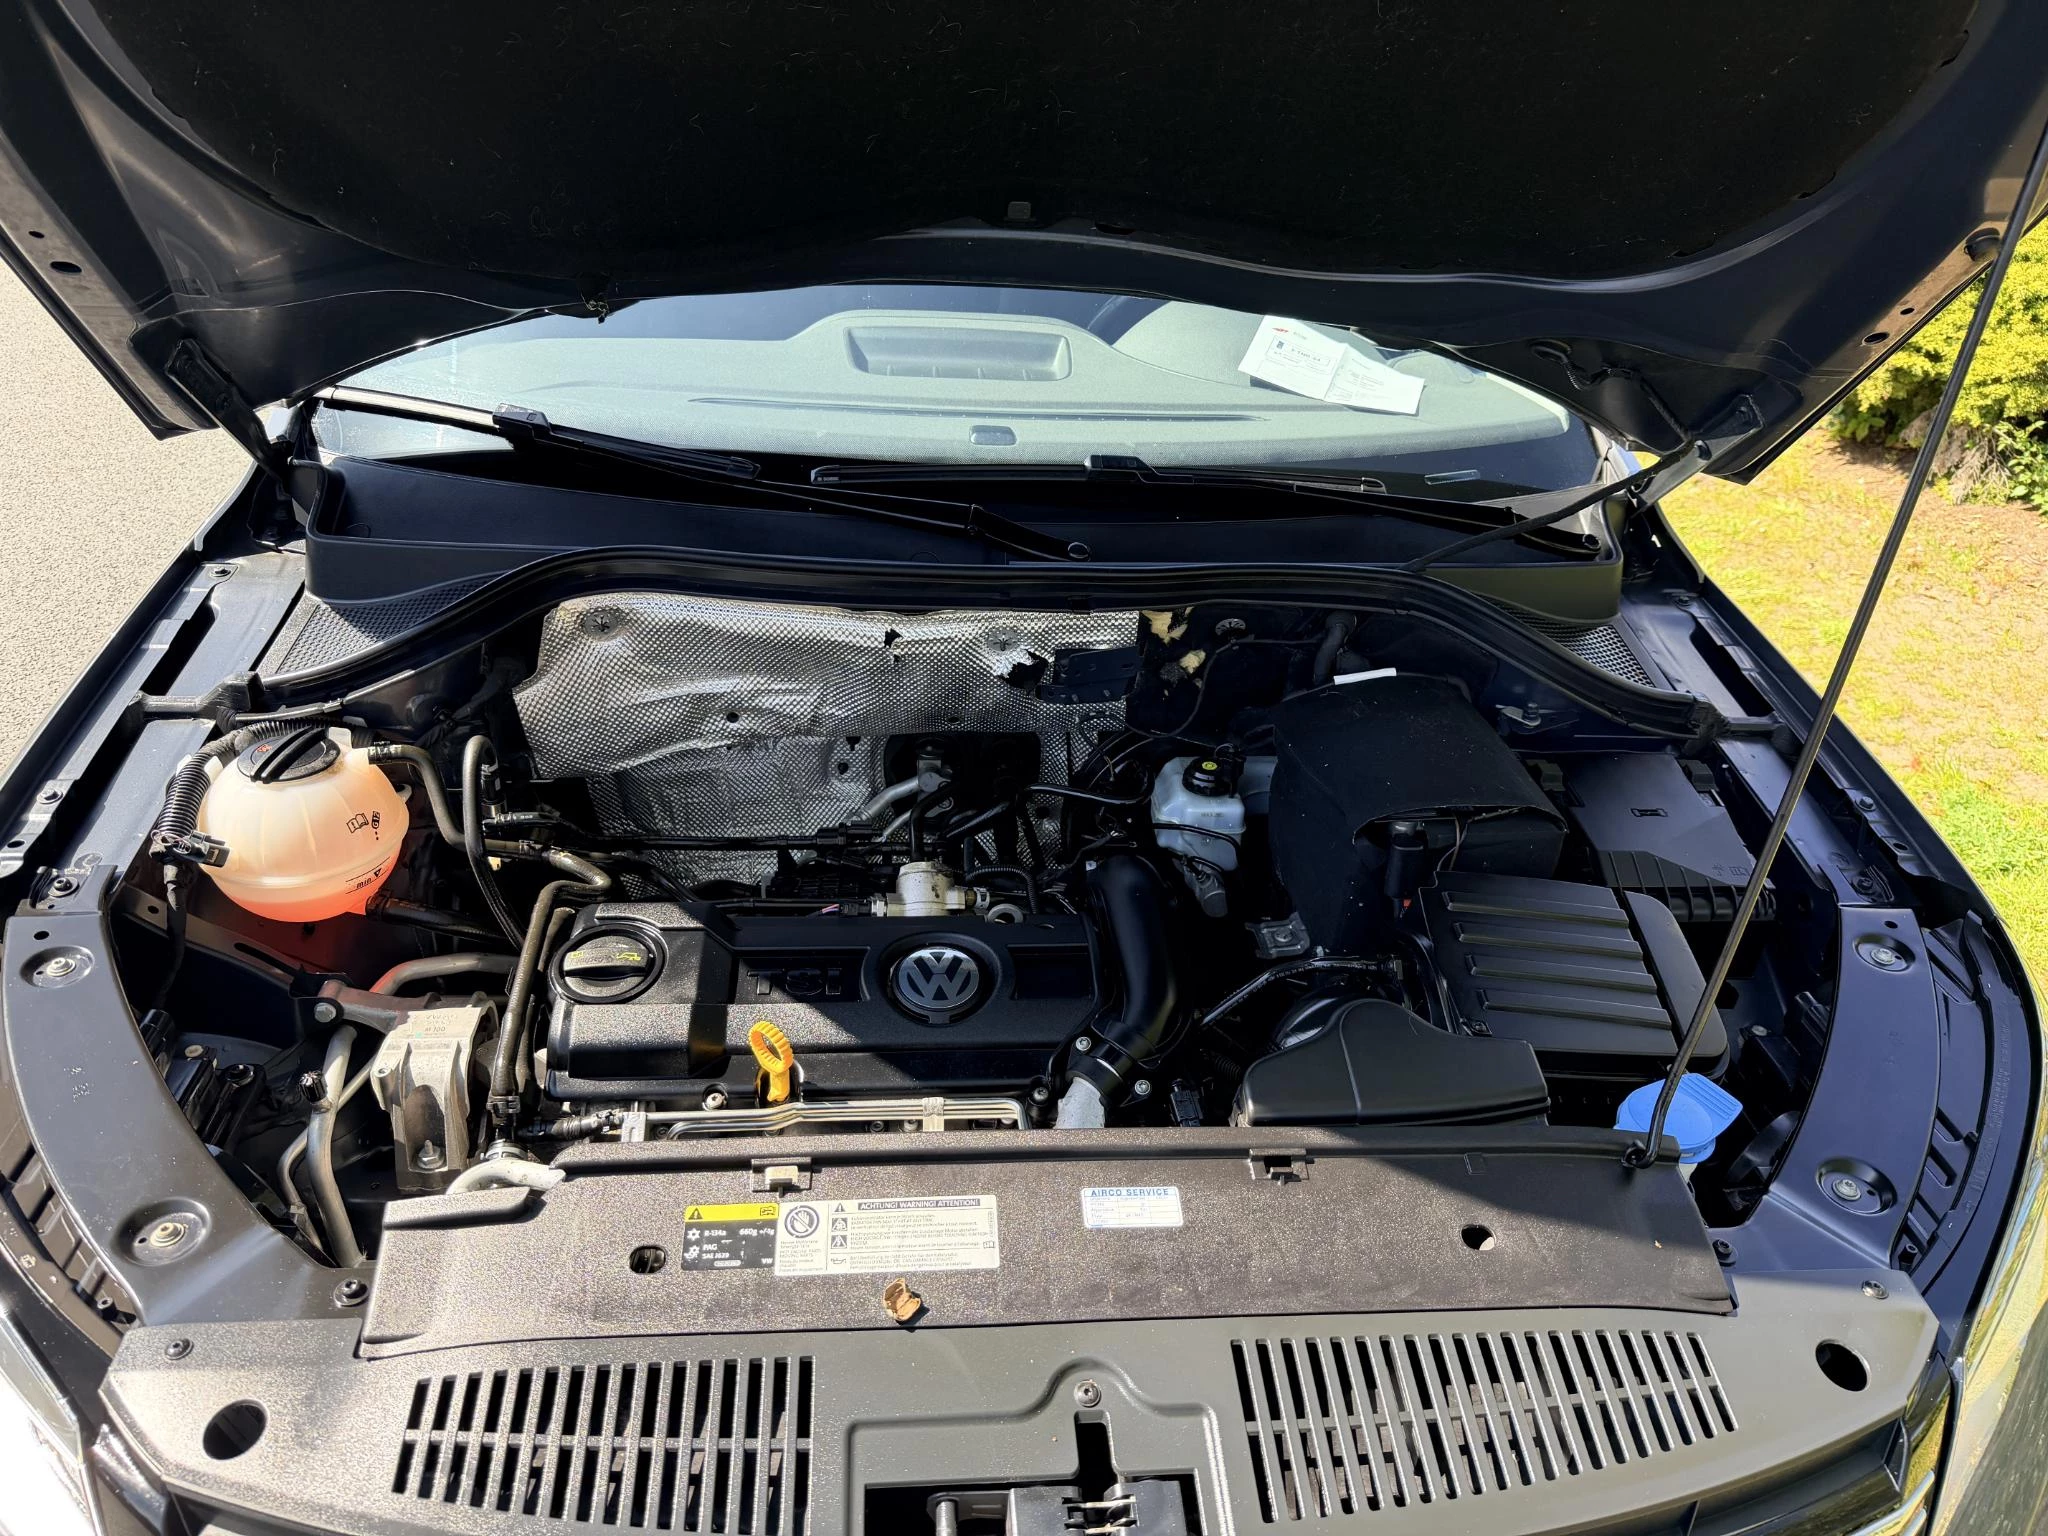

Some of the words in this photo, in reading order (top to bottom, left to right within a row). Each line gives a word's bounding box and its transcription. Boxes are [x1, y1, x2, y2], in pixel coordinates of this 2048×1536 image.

[356, 878, 372, 889] min
[746, 967, 842, 996] TSI
[1126, 1188, 1169, 1196] SERVICE
[860, 1202, 898, 1210] ACHTUNG!
[938, 1199, 979, 1207] ATTENTION!
